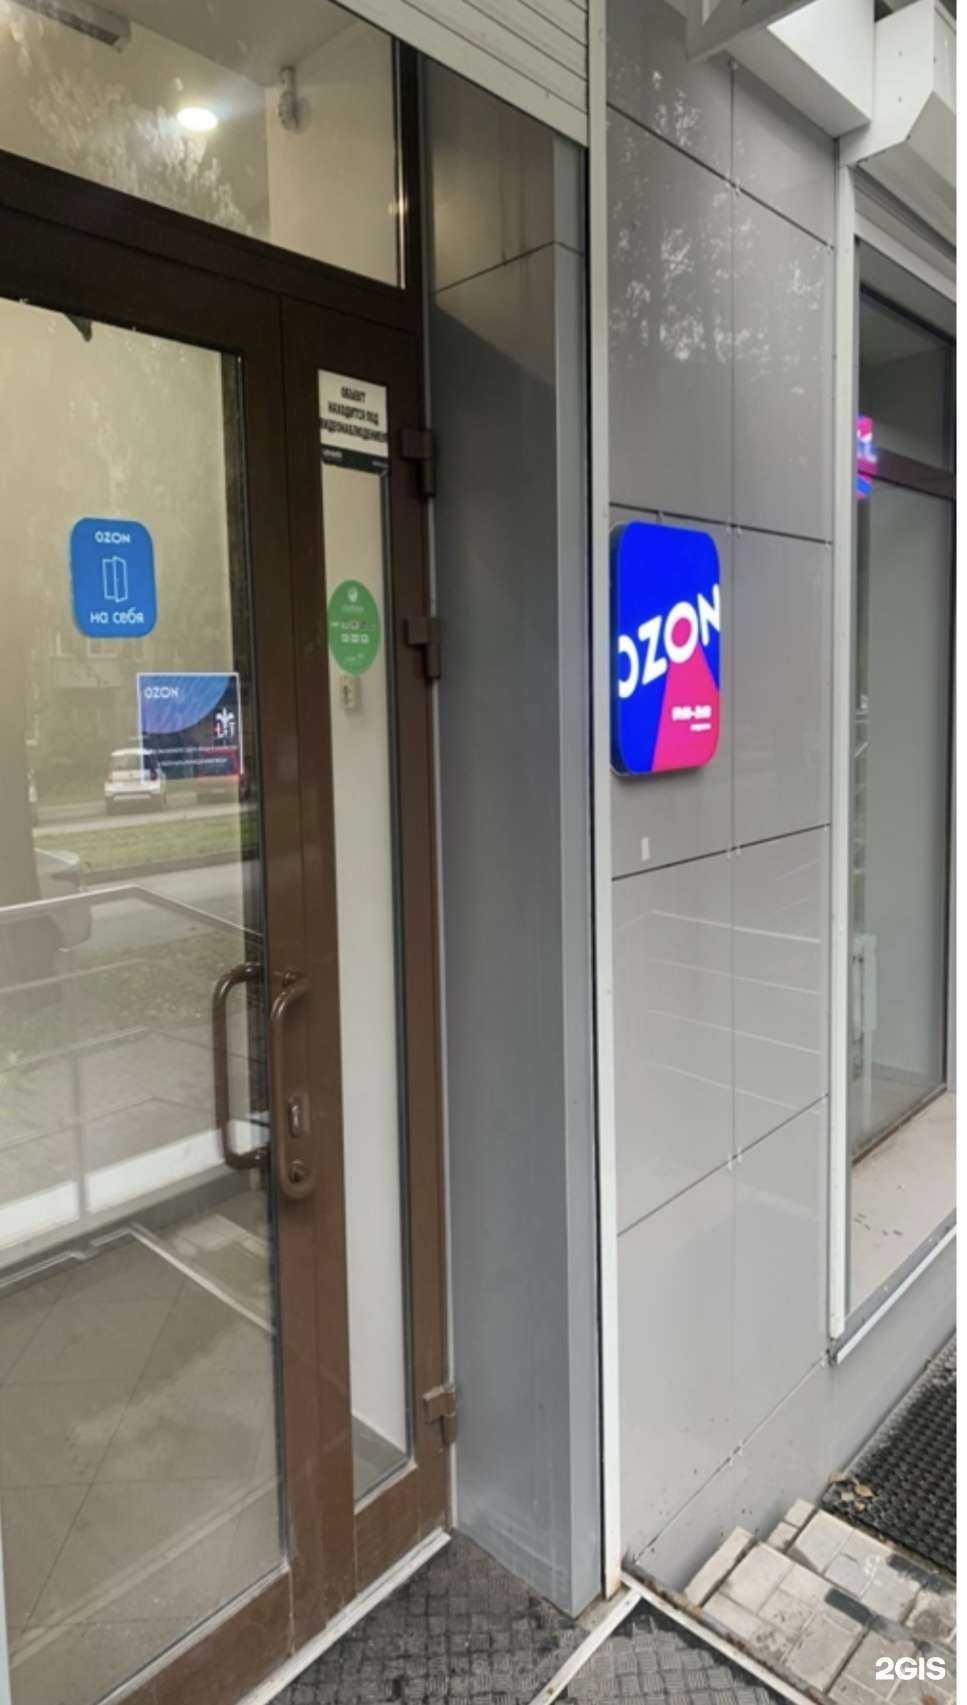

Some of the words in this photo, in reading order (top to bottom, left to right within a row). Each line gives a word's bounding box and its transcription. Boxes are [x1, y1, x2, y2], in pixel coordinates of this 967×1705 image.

[95, 530, 130, 543] OZON
[90, 611, 109, 624] на
[113, 606, 145, 624] себя
[143, 686, 179, 699] OZON
